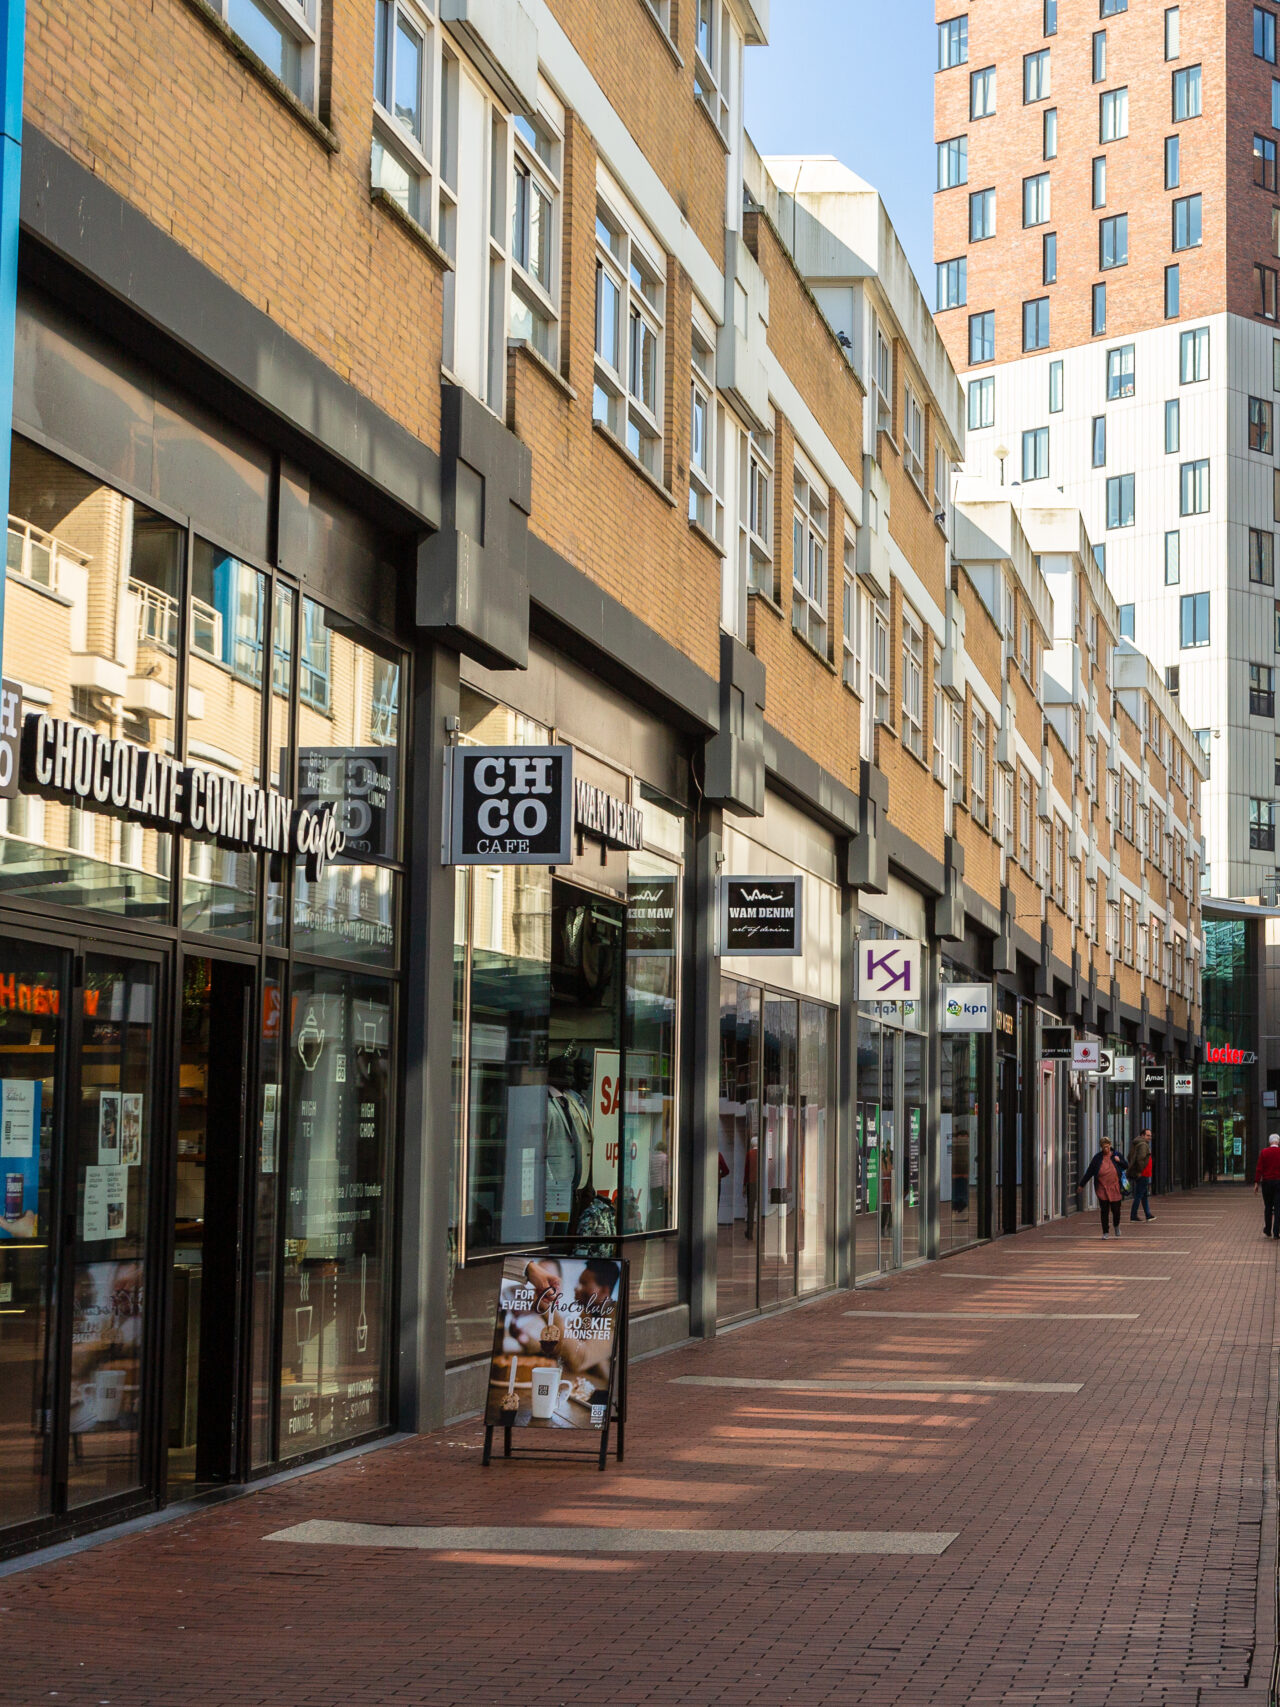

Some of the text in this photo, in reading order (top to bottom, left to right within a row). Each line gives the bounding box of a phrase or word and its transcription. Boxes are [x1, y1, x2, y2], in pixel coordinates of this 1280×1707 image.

[473, 757, 553, 795] CH
[36, 713, 346, 883] CHOCOLATE COMPANY café
[367, 789, 386, 809] LUNCH
[477, 798, 548, 836] CO
[576, 778, 644, 851] WAM DENIM
[477, 839, 530, 854] CAFE
[729, 907, 794, 918] WAM DENIM
[964, 1003, 988, 1016] kpn
[1206, 1041, 1245, 1065] Locker
[1145, 1074, 1164, 1082] Amac
[360, 1103, 375, 1118] HIGH
[360, 1123, 375, 1138] CHOC
[502, 1286, 615, 1315] EVERY Chocolate
[515, 1289, 535, 1300] FOR
[563, 1329, 611, 1341] MONSTER
[350, 1398, 370, 1418] SPOON
[288, 1412, 314, 1435] FONDUE
